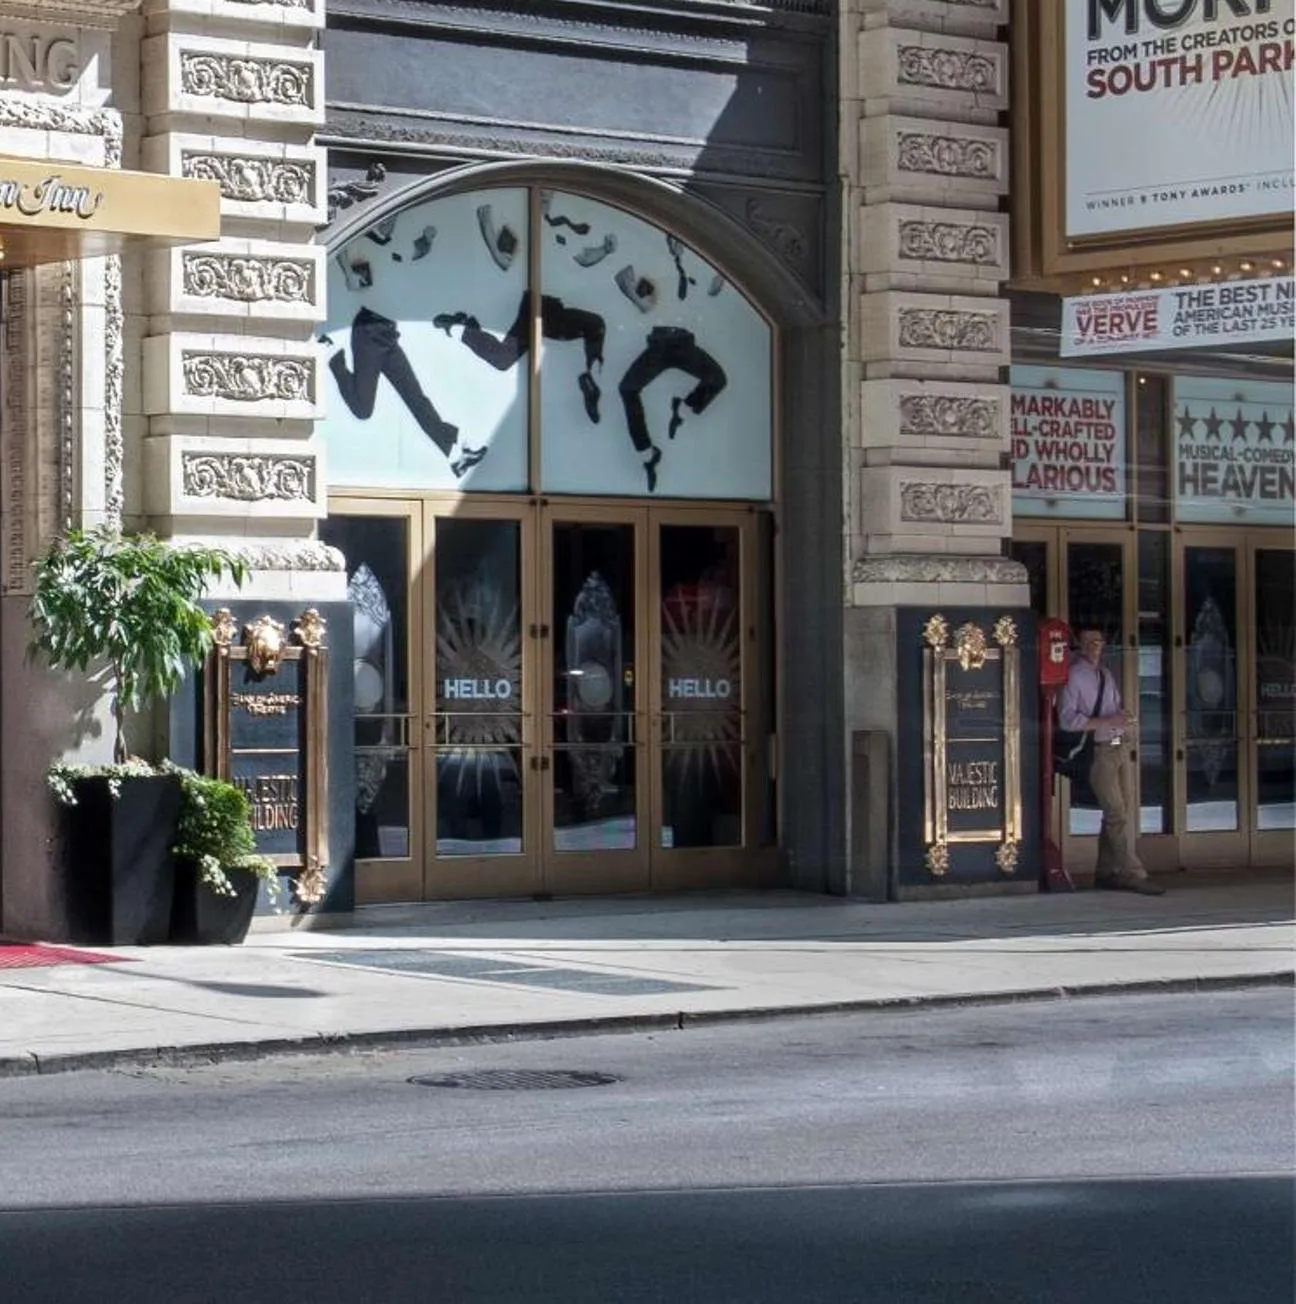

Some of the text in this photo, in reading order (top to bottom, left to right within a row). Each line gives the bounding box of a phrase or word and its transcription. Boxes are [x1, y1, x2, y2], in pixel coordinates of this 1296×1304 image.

[1087, 43, 1138, 66] FROM
[1142, 37, 1177, 57] THE
[1180, 20, 1279, 52] CREATORS
[1086, 54, 1203, 100] SOUTH
[17, 174, 103, 220] Inn
[1085, 195, 1135, 211] WINNER
[1152, 190, 1186, 203] TONY
[1173, 289, 1214, 310] THE
[1219, 283, 1271, 305] BEST
[1076, 309, 1158, 336] VERVE
[1173, 304, 1254, 325] AMERICAN
[1173, 324, 1190, 337] OF
[1196, 322, 1219, 336] THE
[1222, 318, 1256, 333] LAST
[1035, 439, 1116, 464] WHOLLY
[444, 679, 512, 699] HELLO
[669, 679, 731, 698] HELLO
[948, 760, 998, 786] MAJESTIC
[948, 785, 998, 810] BUILDING
